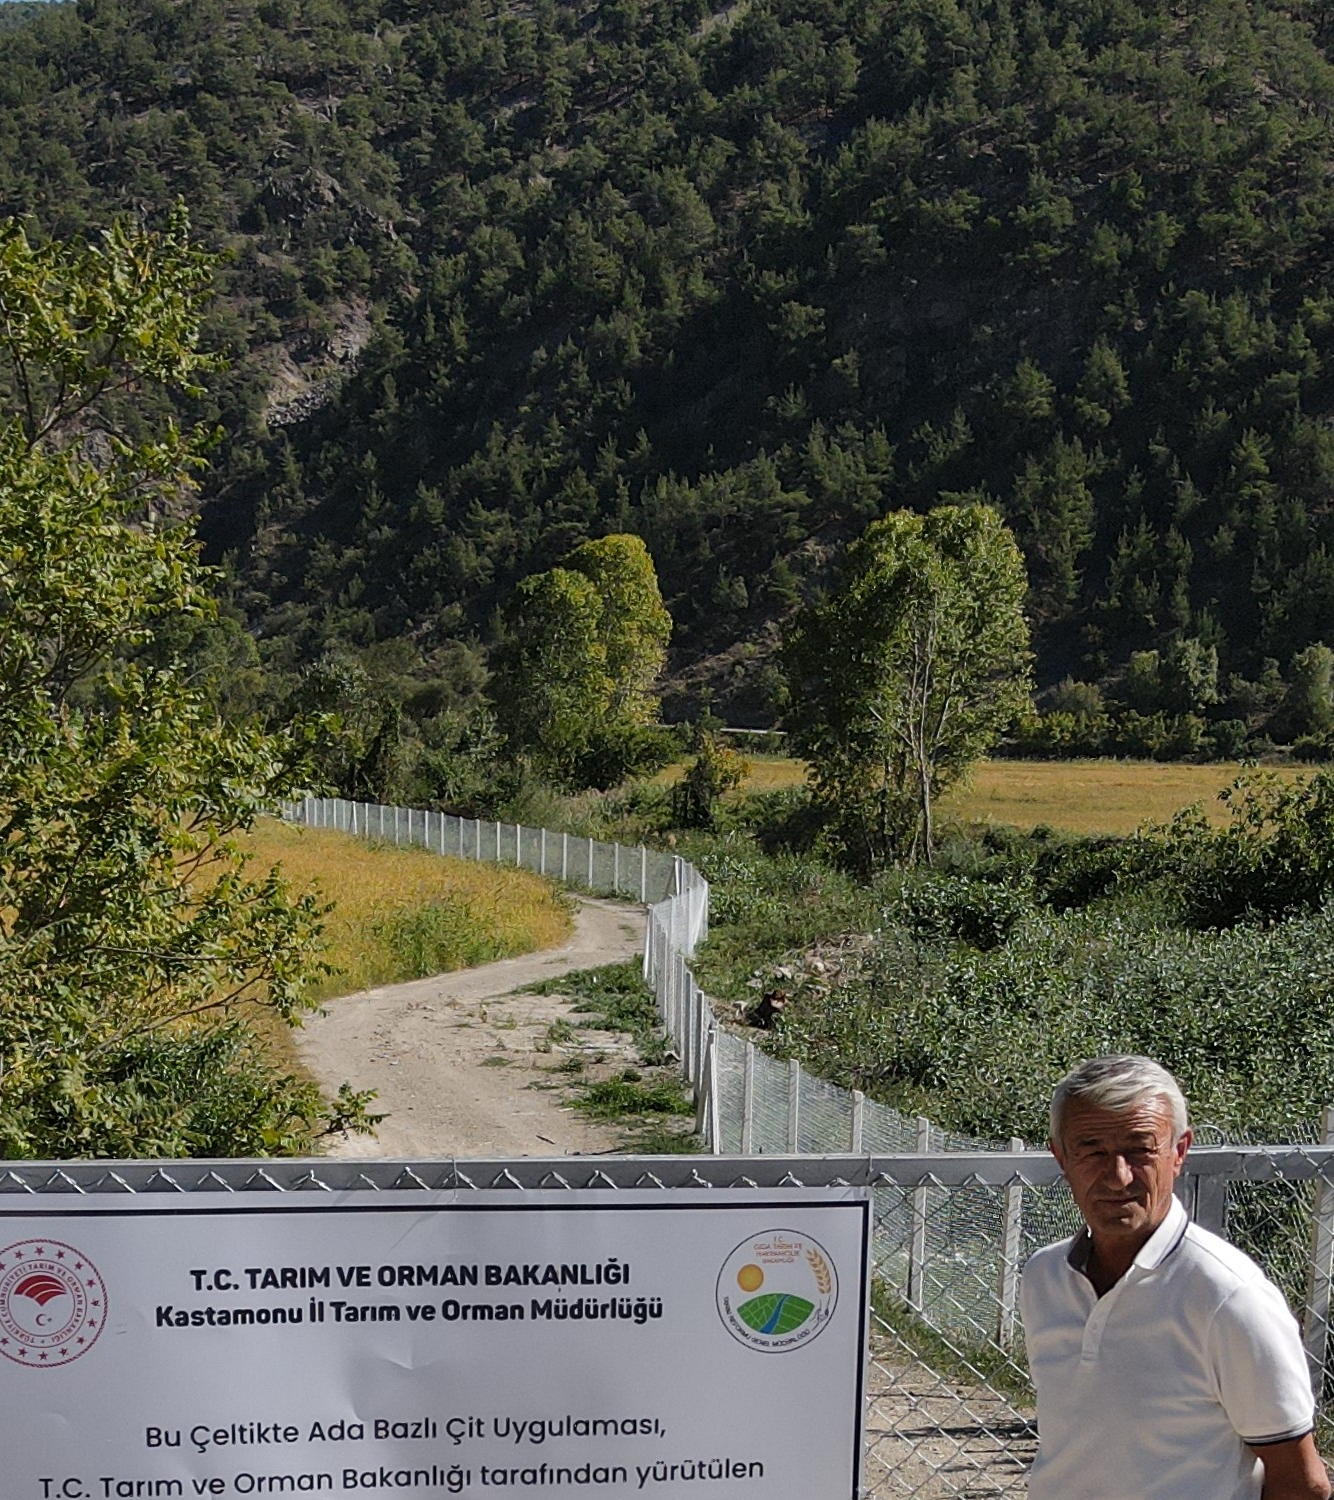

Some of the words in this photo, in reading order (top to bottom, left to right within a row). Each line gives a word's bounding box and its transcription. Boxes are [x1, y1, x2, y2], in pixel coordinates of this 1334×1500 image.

[189, 1268, 240, 1291] T.C.
[244, 1266, 331, 1290] TARIM
[336, 1265, 372, 1288] VE
[377, 1265, 479, 1287] ORMAN
[485, 1257, 630, 1286] BAKANLIĞI
[155, 1305, 303, 1328] Kastamonu
[309, 1296, 325, 1323] İl
[329, 1301, 401, 1323] Tarım
[406, 1304, 436, 1322] ve
[441, 1299, 525, 1321] Orman
[530, 1296, 663, 1325] Müdürlüğü
[145, 1427, 181, 1448] Bu
[190, 1421, 300, 1454] Çeltikte
[308, 1419, 364, 1442] Ada
[373, 1416, 437, 1440] Bazlı
[445, 1415, 485, 1446] Çit
[493, 1414, 666, 1445] Uygulaması,
[38, 1478, 91, 1499] T.C.
[98, 1477, 183, 1499] Tarım
[191, 1477, 226, 1496] ve
[233, 1472, 333, 1494] Orman
[342, 1464, 471, 1494] Bakanlığı
[480, 1462, 628, 1486] tarafından
[635, 1457, 764, 1489] yürütülen
